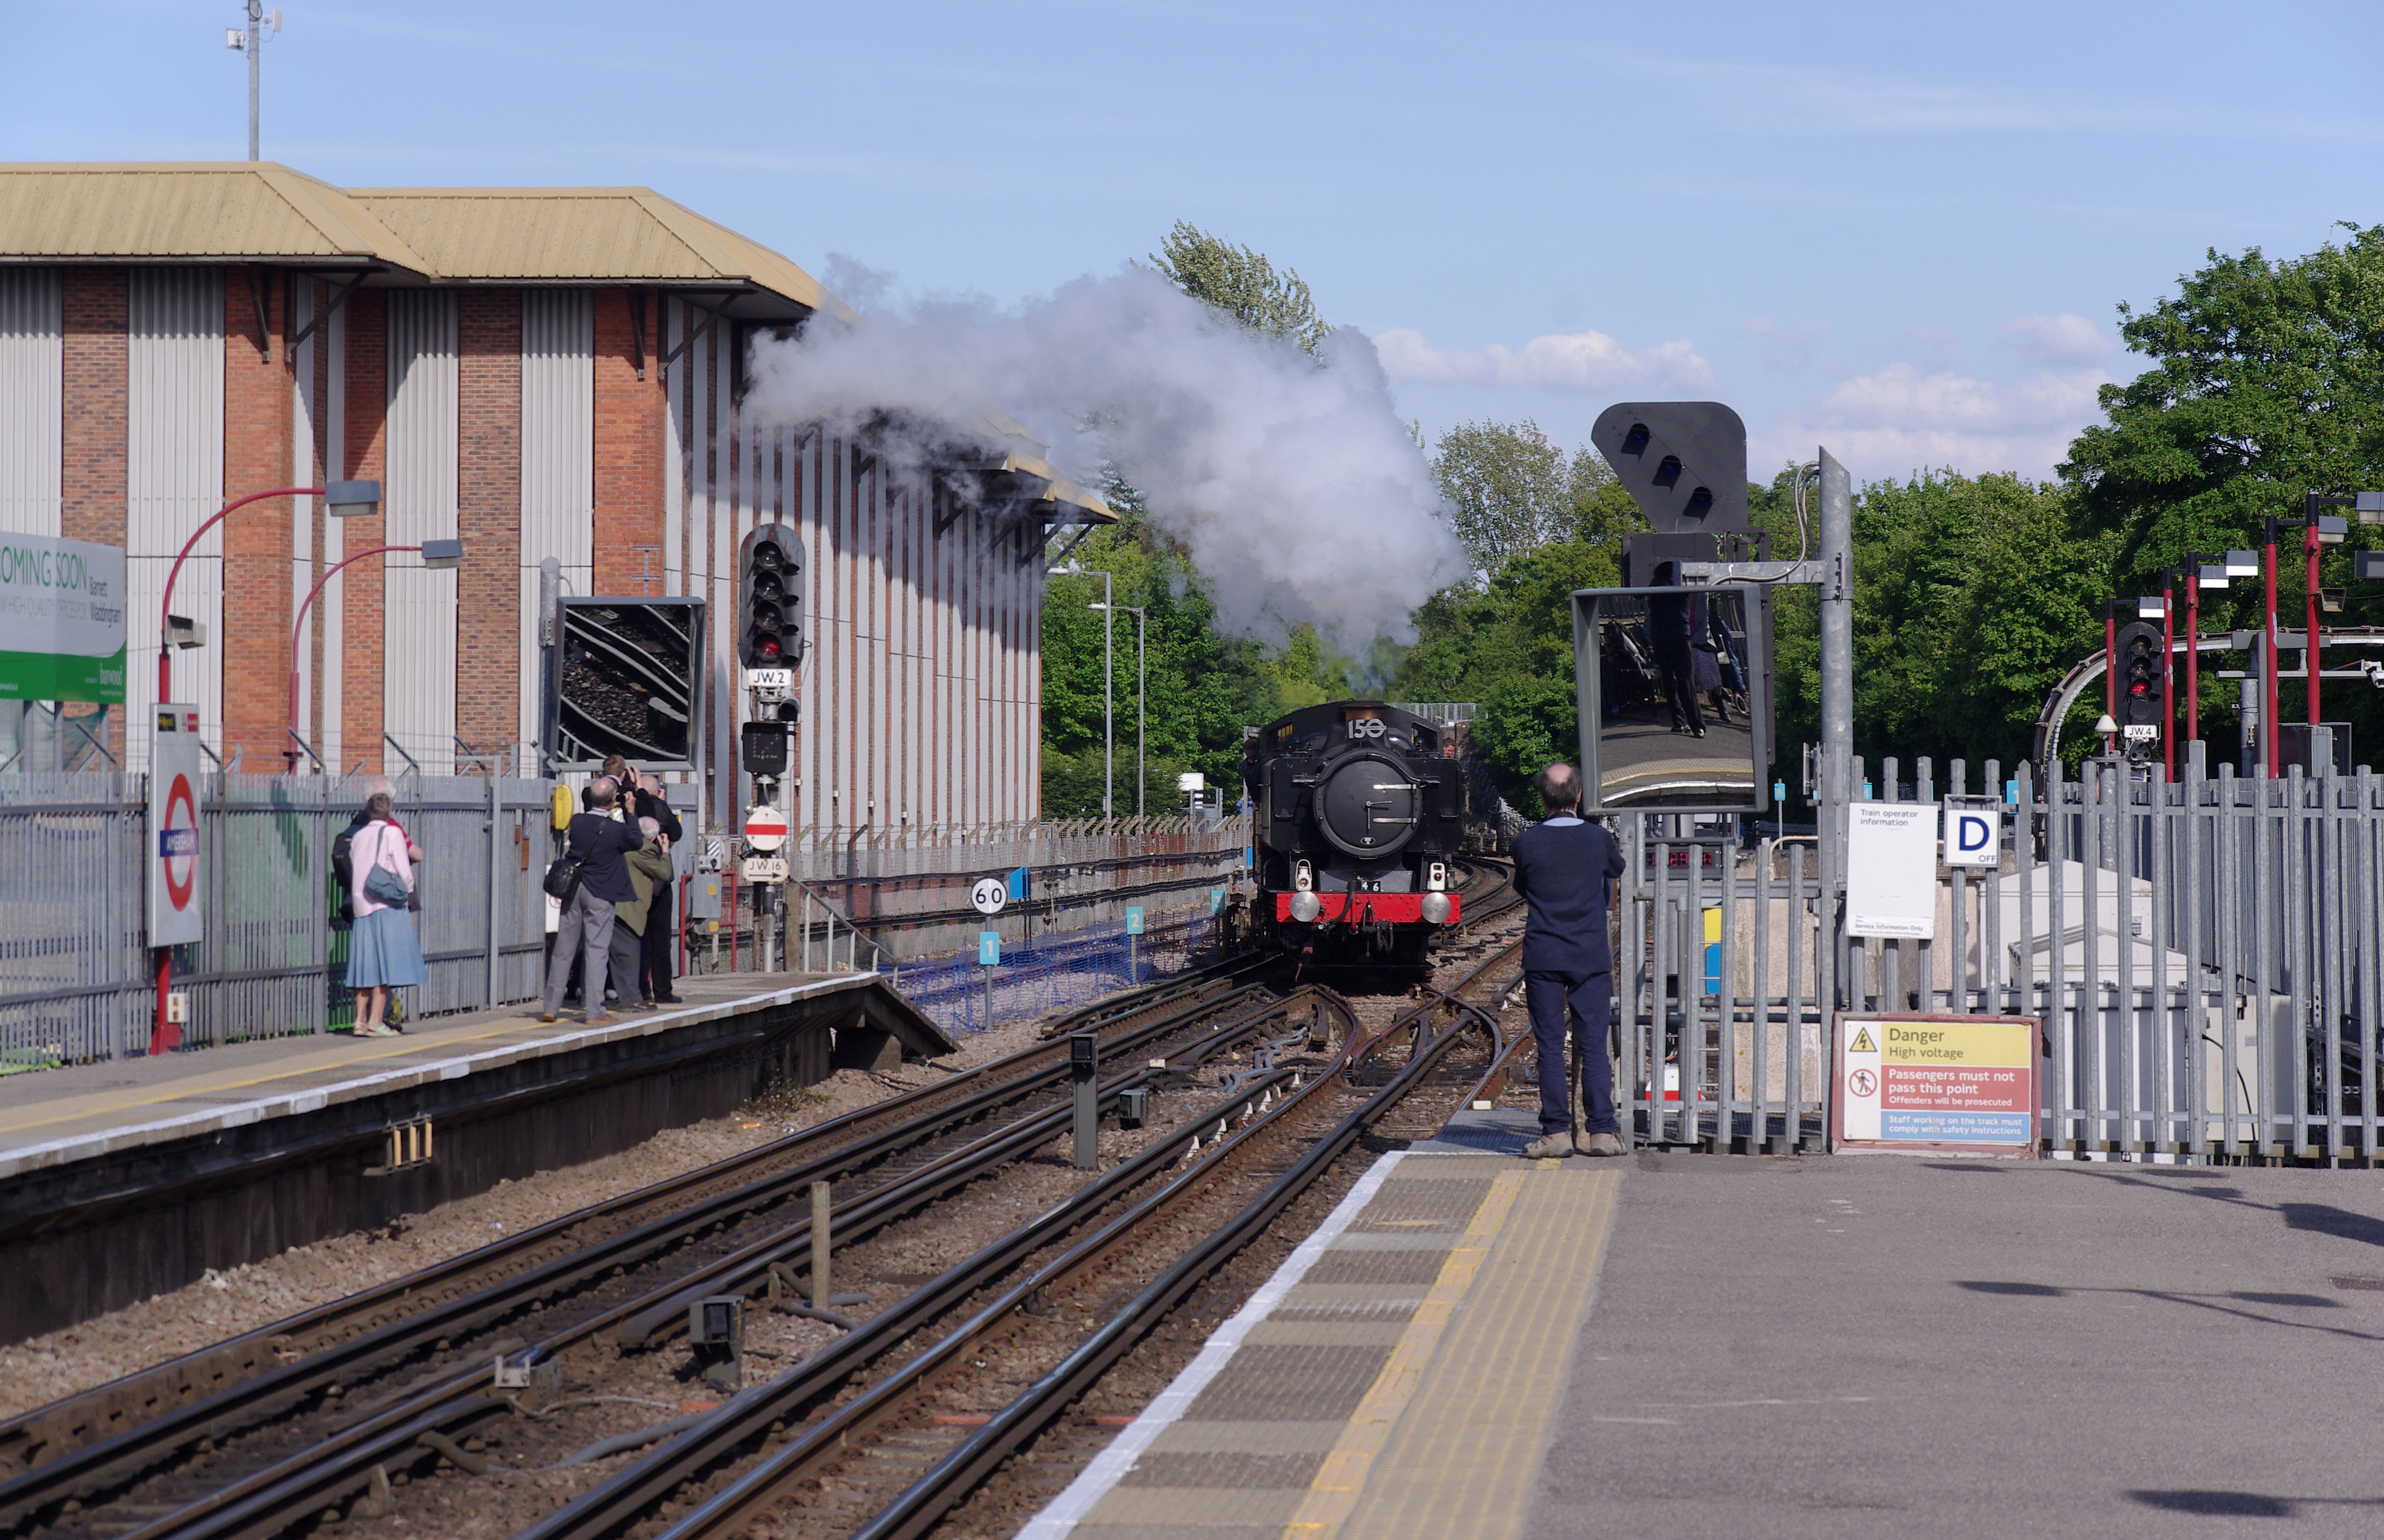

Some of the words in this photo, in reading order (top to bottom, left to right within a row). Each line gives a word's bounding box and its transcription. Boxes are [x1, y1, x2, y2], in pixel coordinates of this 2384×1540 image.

[0, 546, 51, 588] OMING
[56, 550, 87, 591] SOON
[90, 575, 108, 598] Barnett
[90, 600, 122, 629] Waddingham
[754, 672, 785, 683] JW.2
[2129, 727, 2152, 736] JW.4
[1861, 808, 1880, 817] Train
[1883, 810, 1918, 818] operator
[1861, 818, 1908, 827] information
[1959, 816, 1990, 851] D
[166, 834, 194, 852] AMERSHAM
[976, 888, 1002, 904] 60
[1214, 895, 1222, 908] 3
[1131, 914, 1140, 928] 2
[986, 940, 994, 956] 1
[1890, 1028, 1945, 1045] Danger
[1890, 1046, 1915, 1059] High
[1920, 1048, 1964, 1060] voltage
[1889, 1068, 1955, 1082] Passengers
[1959, 1072, 1990, 1081] must
[1994, 1072, 2015, 1082] not
[1889, 1084, 1915, 1095] pass
[1920, 1083, 1943, 1094] this
[1947, 1084, 1978, 1096] point
[1889, 1096, 1932, 1104] Offenders
[1934, 1097, 1950, 1105] will
[1965, 1098, 2012, 1107] prosecuted
[1889, 1116, 1911, 1124] Staff
[1913, 1116, 1945, 1126] working
[1978, 1117, 1998, 1126] track
[1889, 1125, 1919, 1134] comply
[1942, 1126, 1969, 1135] safety
[1971, 1127, 2021, 1135] instructions
